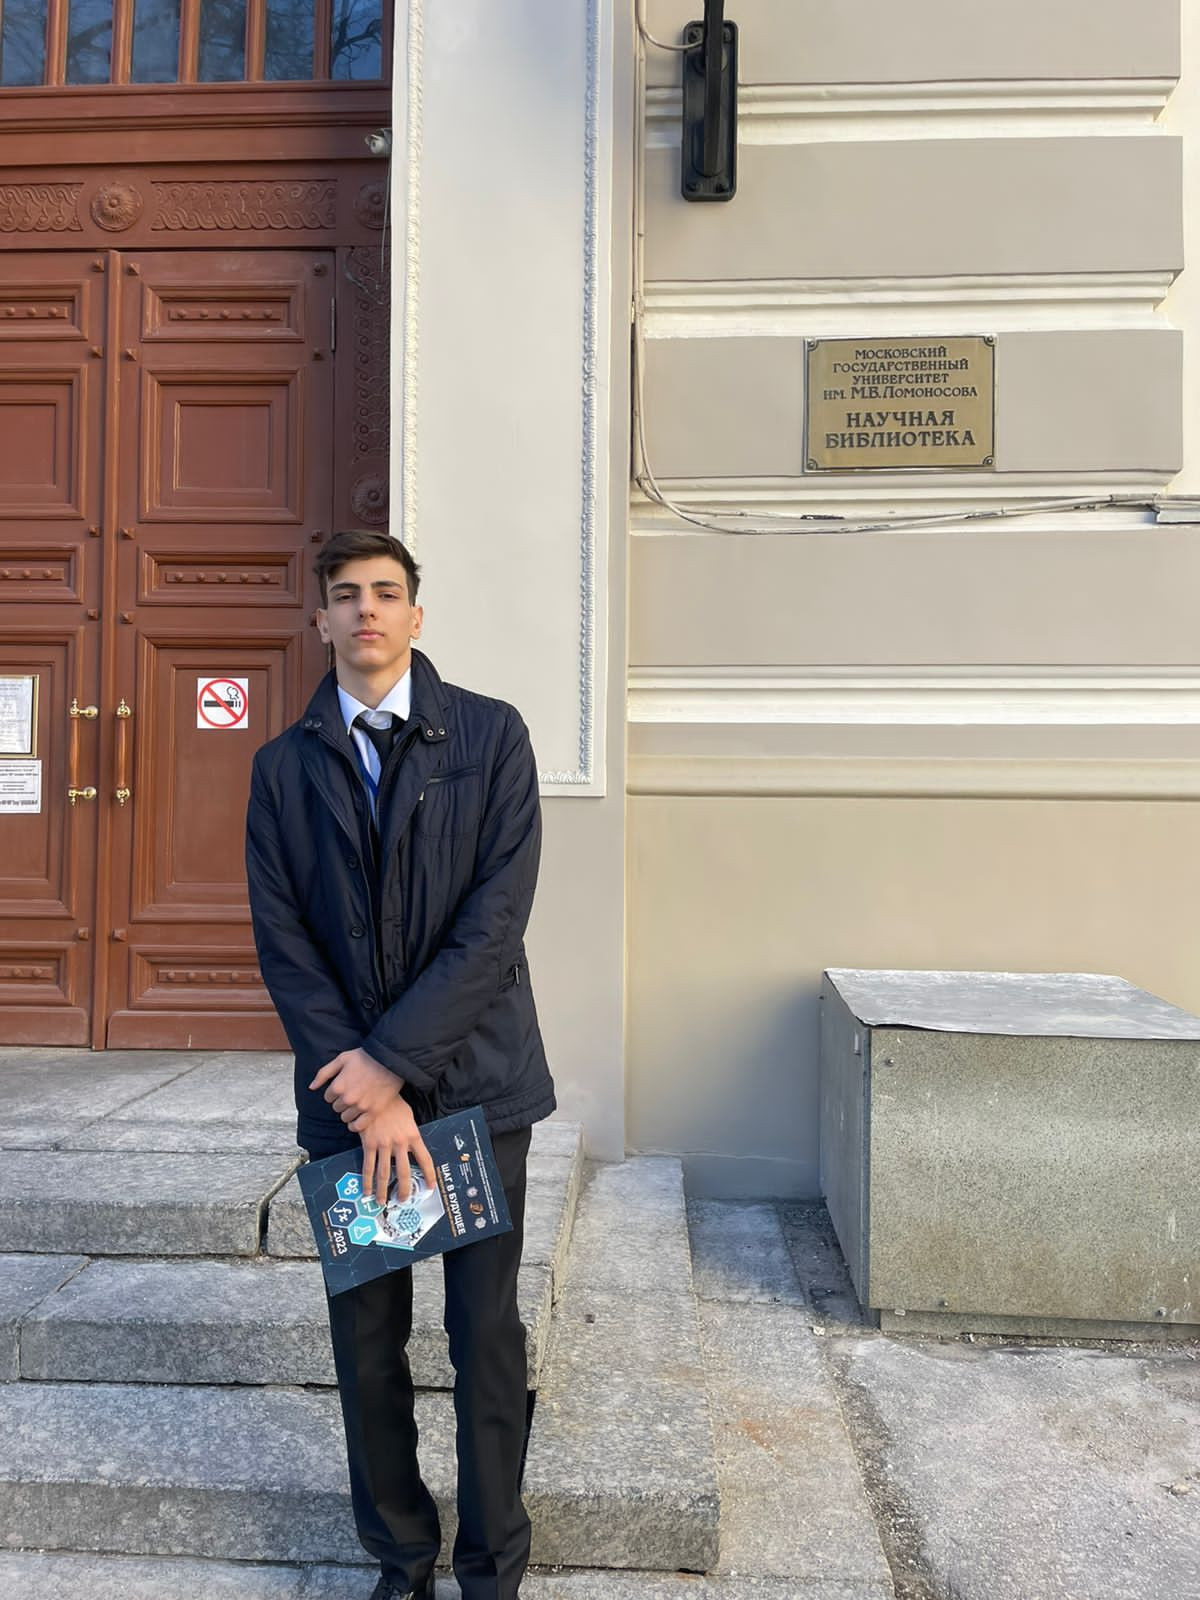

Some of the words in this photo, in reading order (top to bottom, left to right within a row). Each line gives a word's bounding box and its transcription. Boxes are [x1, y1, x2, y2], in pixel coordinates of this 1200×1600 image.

[855, 345, 947, 360] МОСКОВСКИЙ
[833, 358, 969, 373] ГОСУДАРСТВЕННЫЙ
[852, 373, 949, 385] УНИВЕРСИТЕТ
[846, 410, 955, 428] НАУЧНАЯ
[825, 430, 976, 449] БИБЛИОТЕКА
[441, 1163, 453, 1183] ШАГ
[446, 1184, 455, 1192] В
[448, 1192, 467, 1236] БУДУЩЕЕ
[333, 1230, 348, 1254] 2023
